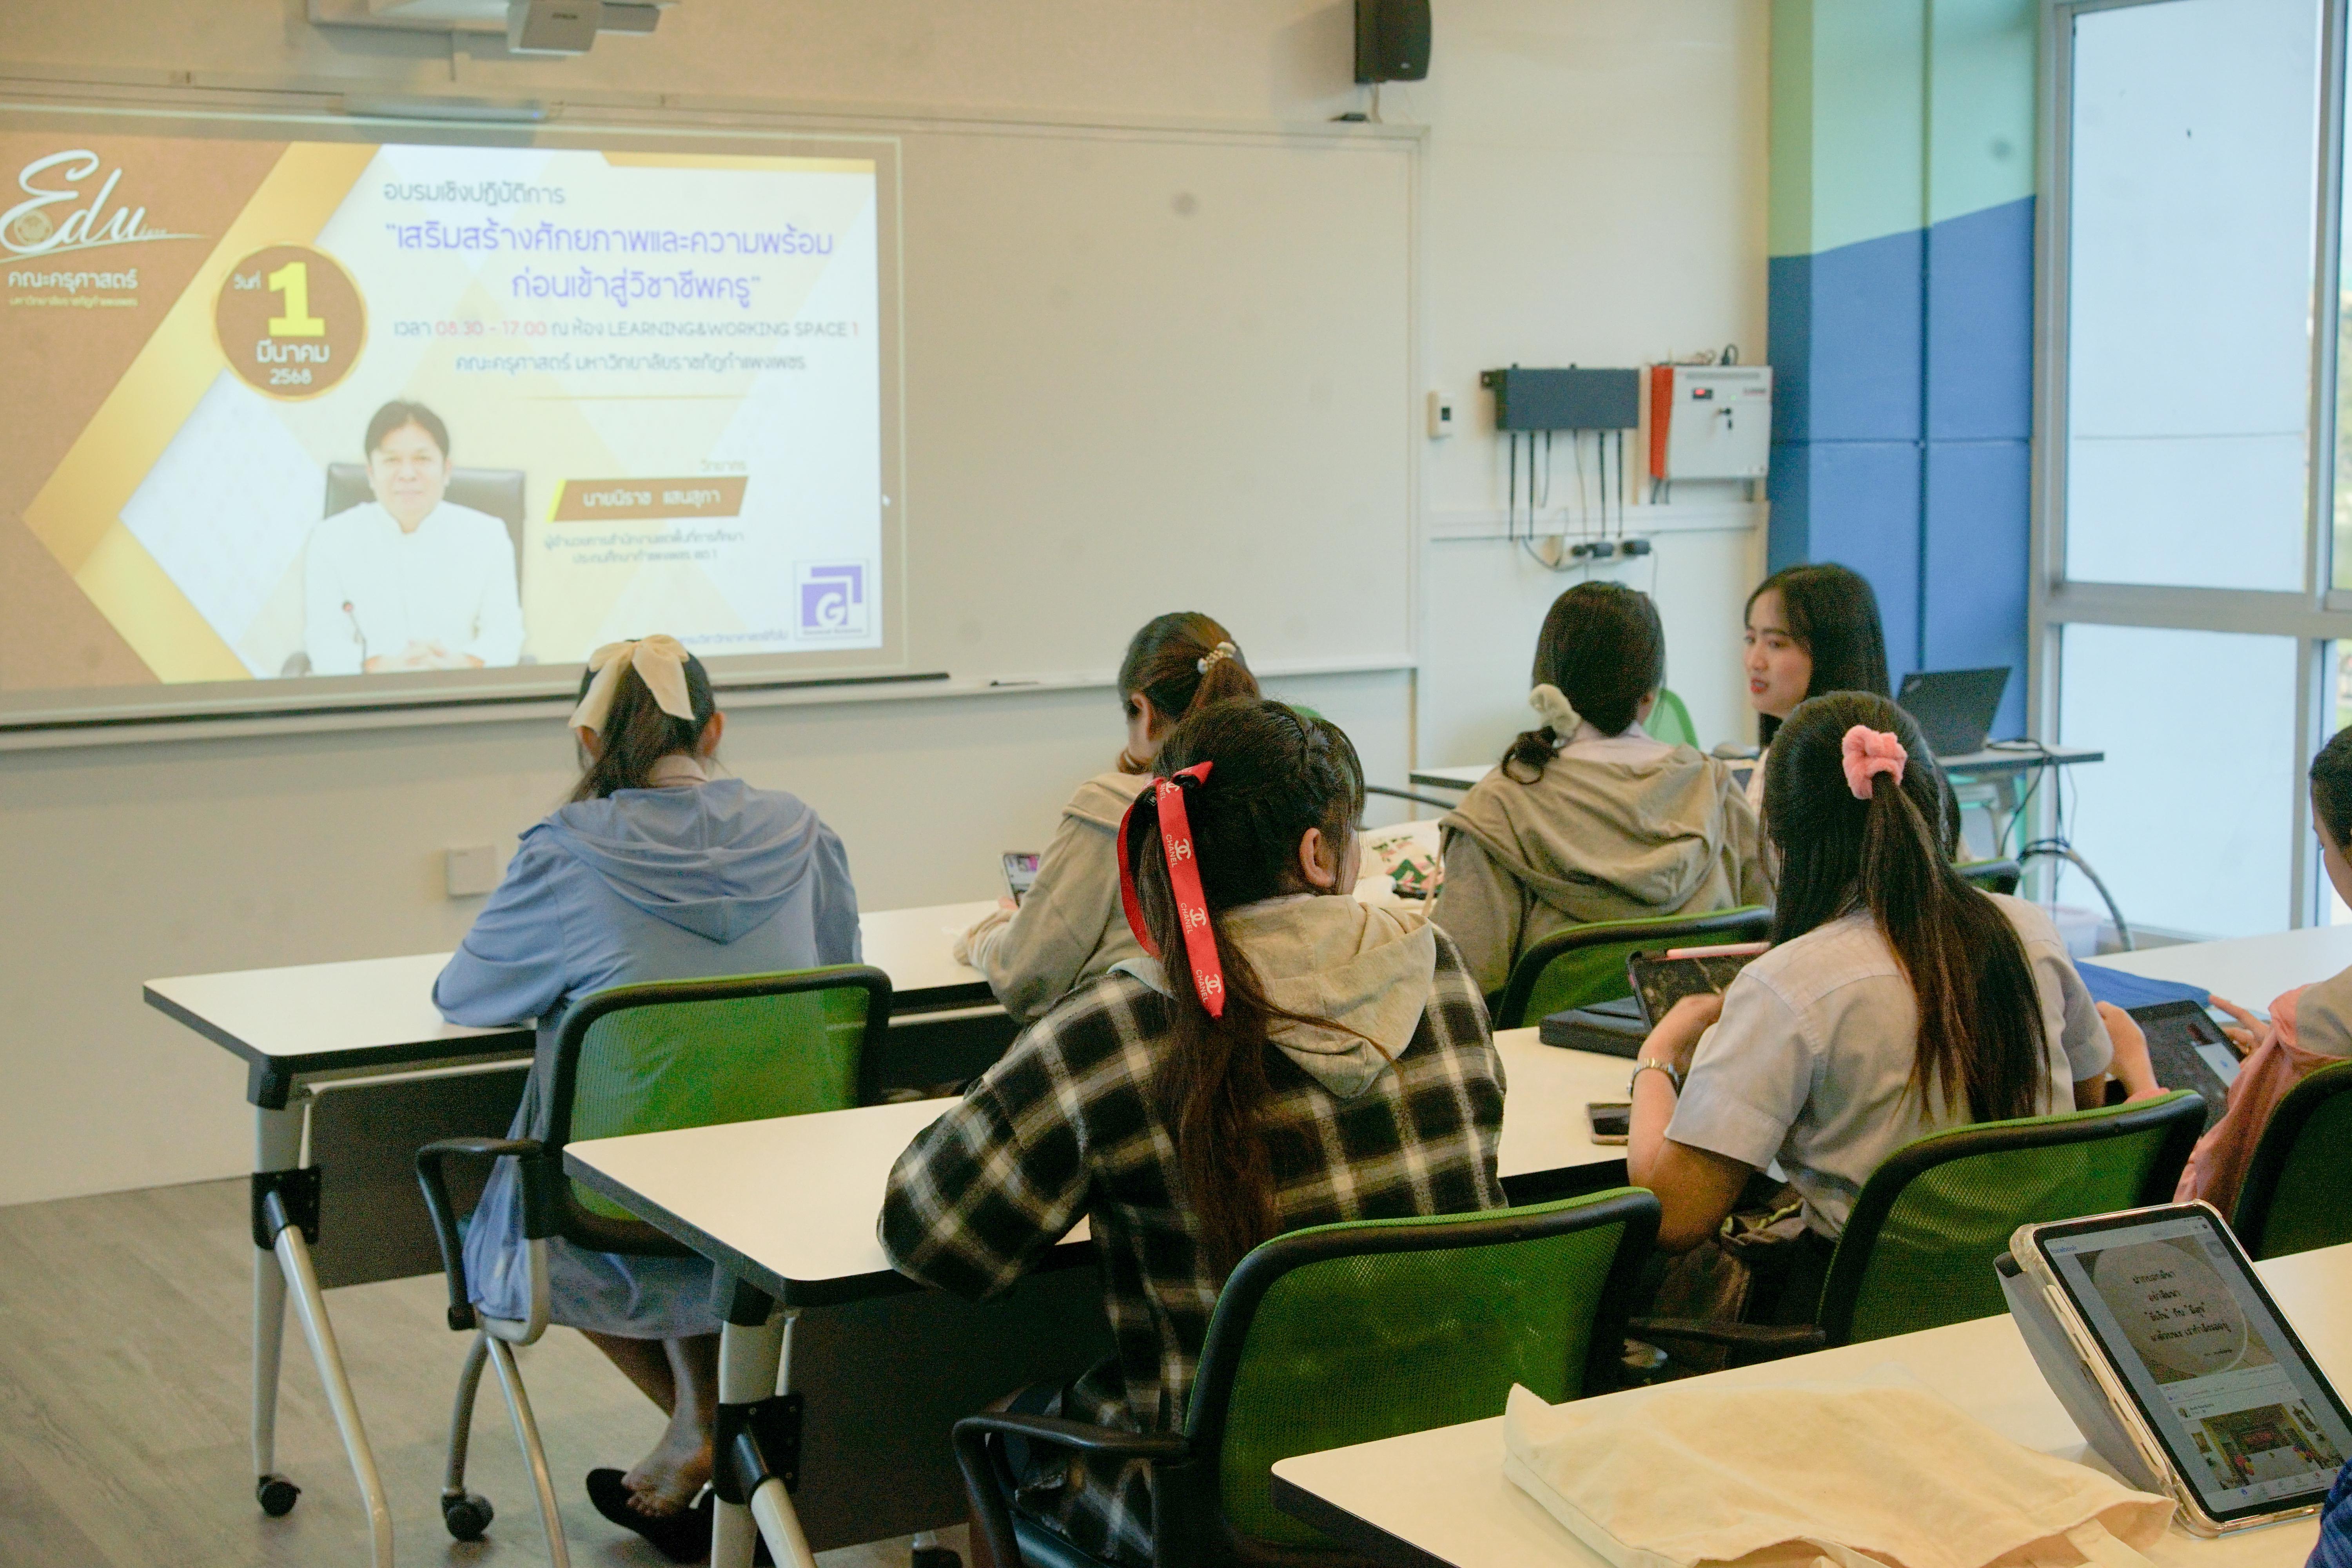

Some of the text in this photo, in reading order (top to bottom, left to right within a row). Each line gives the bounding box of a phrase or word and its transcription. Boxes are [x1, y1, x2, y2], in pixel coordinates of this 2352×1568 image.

[0, 148, 146, 256] Edu
[384, 181, 565, 206] อบรมเชิงปฏิบัติการ
[8, 268, 138, 294] คณะครุศาสตร์
[234, 261, 325, 337] วันที่ 1
[394, 320, 431, 336] เวลา
[609, 321, 790, 337] LEARNING&WORKING
[794, 322, 848, 337] SPACE
[256, 338, 330, 363] มีนาคม
[269, 368, 312, 385] 2568
[1166, 834, 1178, 867] CHANEL
[1180, 903, 1194, 934] CHANEL
[1196, 969, 1209, 1003] CHANEL
